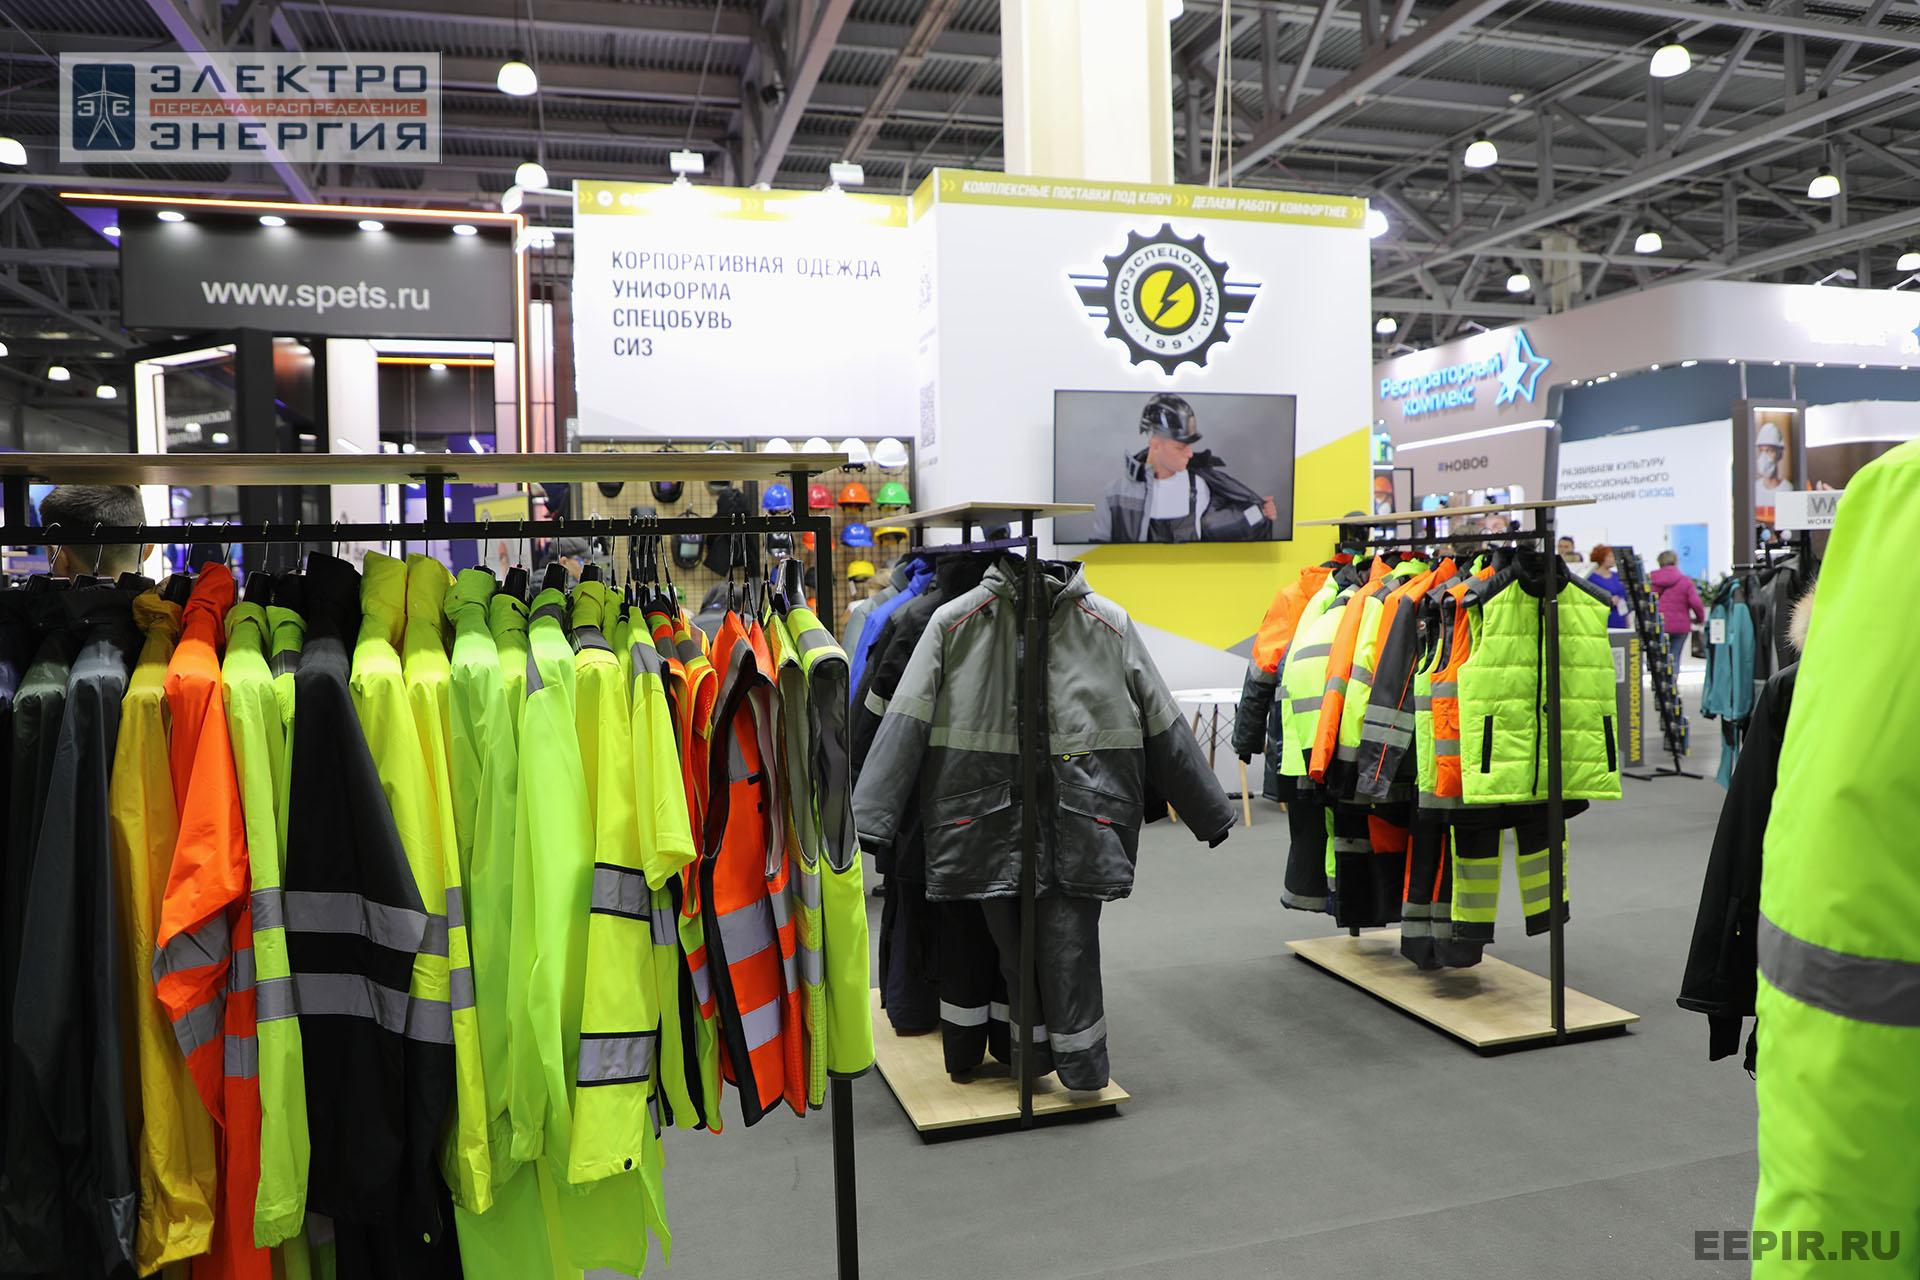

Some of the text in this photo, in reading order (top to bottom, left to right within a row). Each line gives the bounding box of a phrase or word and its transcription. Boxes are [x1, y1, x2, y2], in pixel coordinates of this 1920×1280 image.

[962, 179, 1173, 206] КОМПЛЕКСНЫЕ ПОСТАВКИ ПОД КЛЮЧ
[1192, 194, 1348, 219] ДЕЛАЕМ РАБОТУ КОМФОРТНЕЕ
[612, 250, 882, 280] КОРПОРАТИВНАЯ ОДЕЖДА
[201, 281, 430, 314] www.spets.ru
[612, 279, 732, 301] УНИФОРМА
[1120, 247, 1215, 327] СОЮЗСПЕЦОДЕЖДА
[613, 308, 733, 331] СПЕЦОБУВЬ
[613, 337, 653, 357] СИЗ
[1144, 334, 1195, 350] 1991
[1380, 352, 1503, 399] Респираторный
